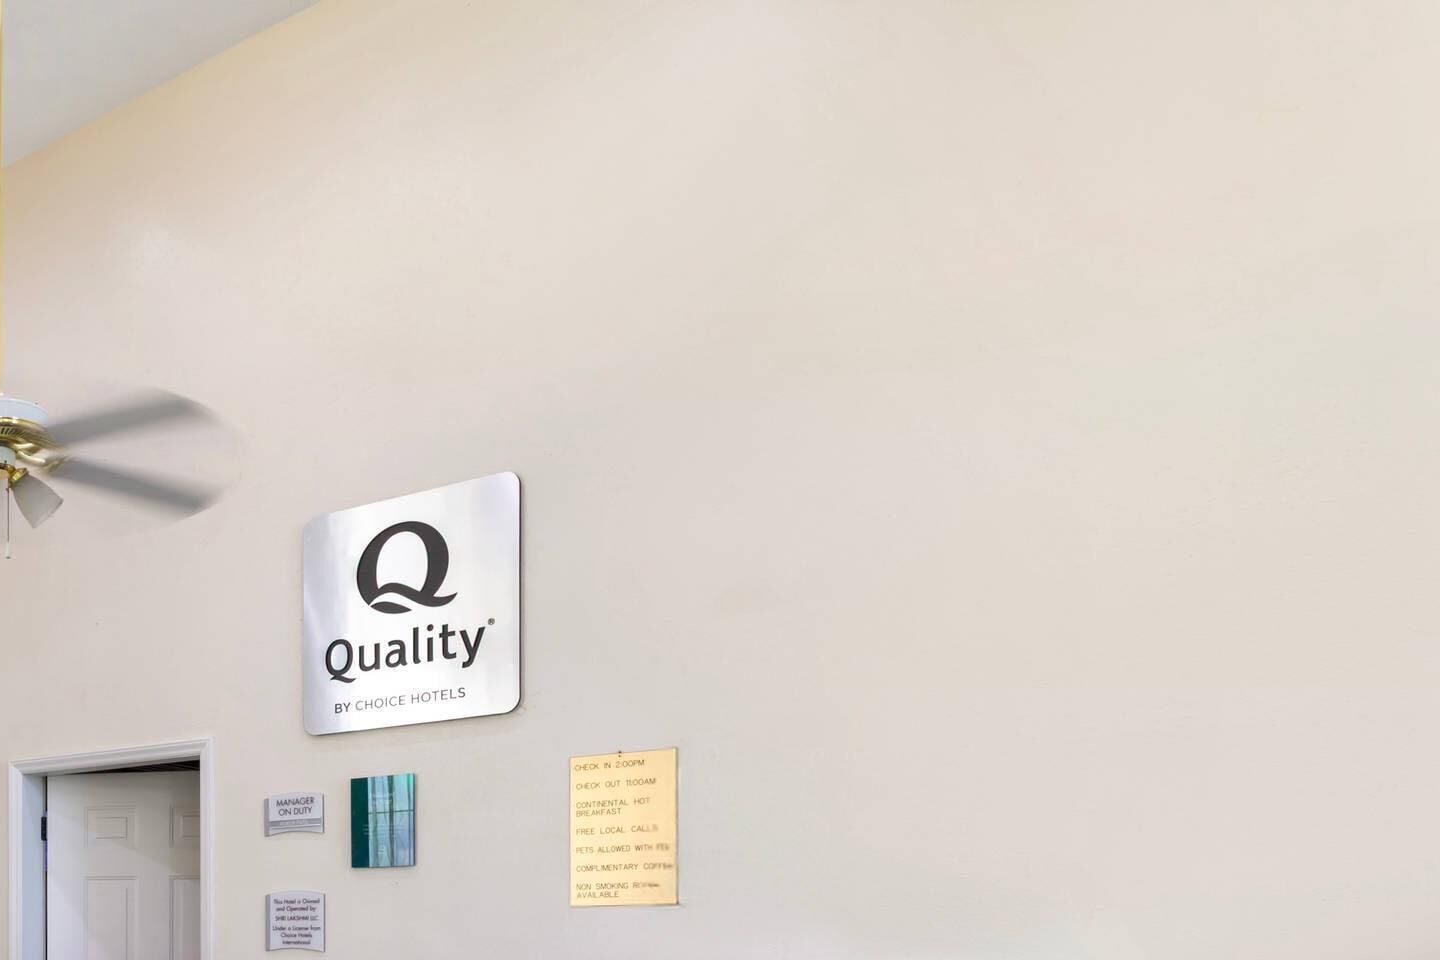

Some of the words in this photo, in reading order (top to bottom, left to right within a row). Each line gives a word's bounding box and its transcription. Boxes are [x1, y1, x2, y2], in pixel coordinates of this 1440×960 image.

[325, 624, 486, 684] Quality
[333, 701, 351, 714] BY
[354, 695, 407, 712] CHOICE
[410, 686, 467, 705] HOTELS
[574, 763, 599, 771] CHECK
[615, 759, 645, 769] 2:00PM
[575, 782, 601, 790] CHECK
[605, 780, 621, 788] OUT
[275, 796, 314, 807] MANAGER
[575, 799, 629, 809] CONTINENTAL
[633, 797, 650, 805] HOT
[278, 808, 292, 817] ON
[293, 806, 312, 815] DUTY
[575, 808, 622, 818] BREAKFAST
[575, 828, 595, 836] FREE
[599, 826, 627, 835] LOCAL
[575, 846, 594, 854] PETS
[597, 845, 631, 853] ALLOWED
[575, 864, 639, 872] COMPLIMENTARY
[595, 882, 629, 890] SMOKING
[576, 890, 620, 899] AVAILABLE
[286, 905, 309, 913] Operated
